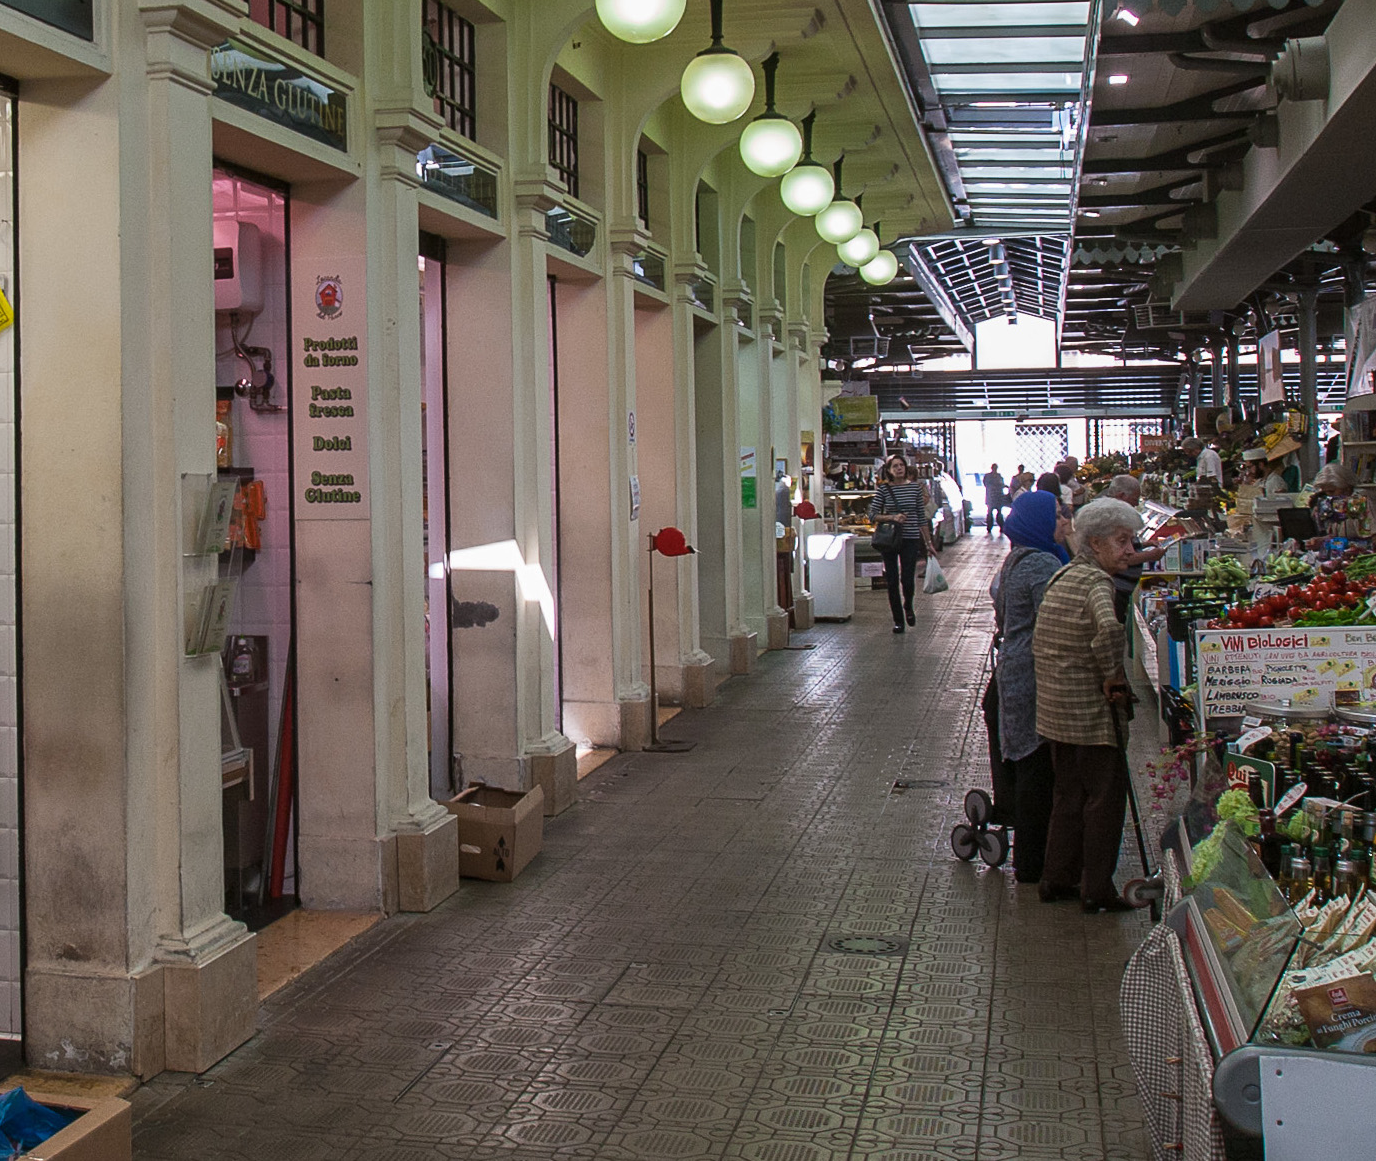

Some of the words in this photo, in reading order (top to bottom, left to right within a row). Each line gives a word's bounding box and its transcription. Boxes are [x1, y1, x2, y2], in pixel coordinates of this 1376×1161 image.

[212, 46, 271, 104] SENZA
[274, 78, 345, 137] GLUTINE
[303, 336, 358, 351] Prodotti
[303, 354, 320, 367] da
[322, 354, 358, 367] forno
[311, 386, 351, 400] Pasta
[309, 403, 354, 417] fresca
[313, 436, 352, 451] Dolci
[311, 471, 353, 486] Senza
[305, 488, 361, 503] Glutine
[1207, 665, 1251, 674] BARBERA
[1206, 689, 1260, 701] LAMBRUSCO
[1331, 1009, 1362, 1023] Crema
[1323, 1019, 1353, 1036] Funghi
